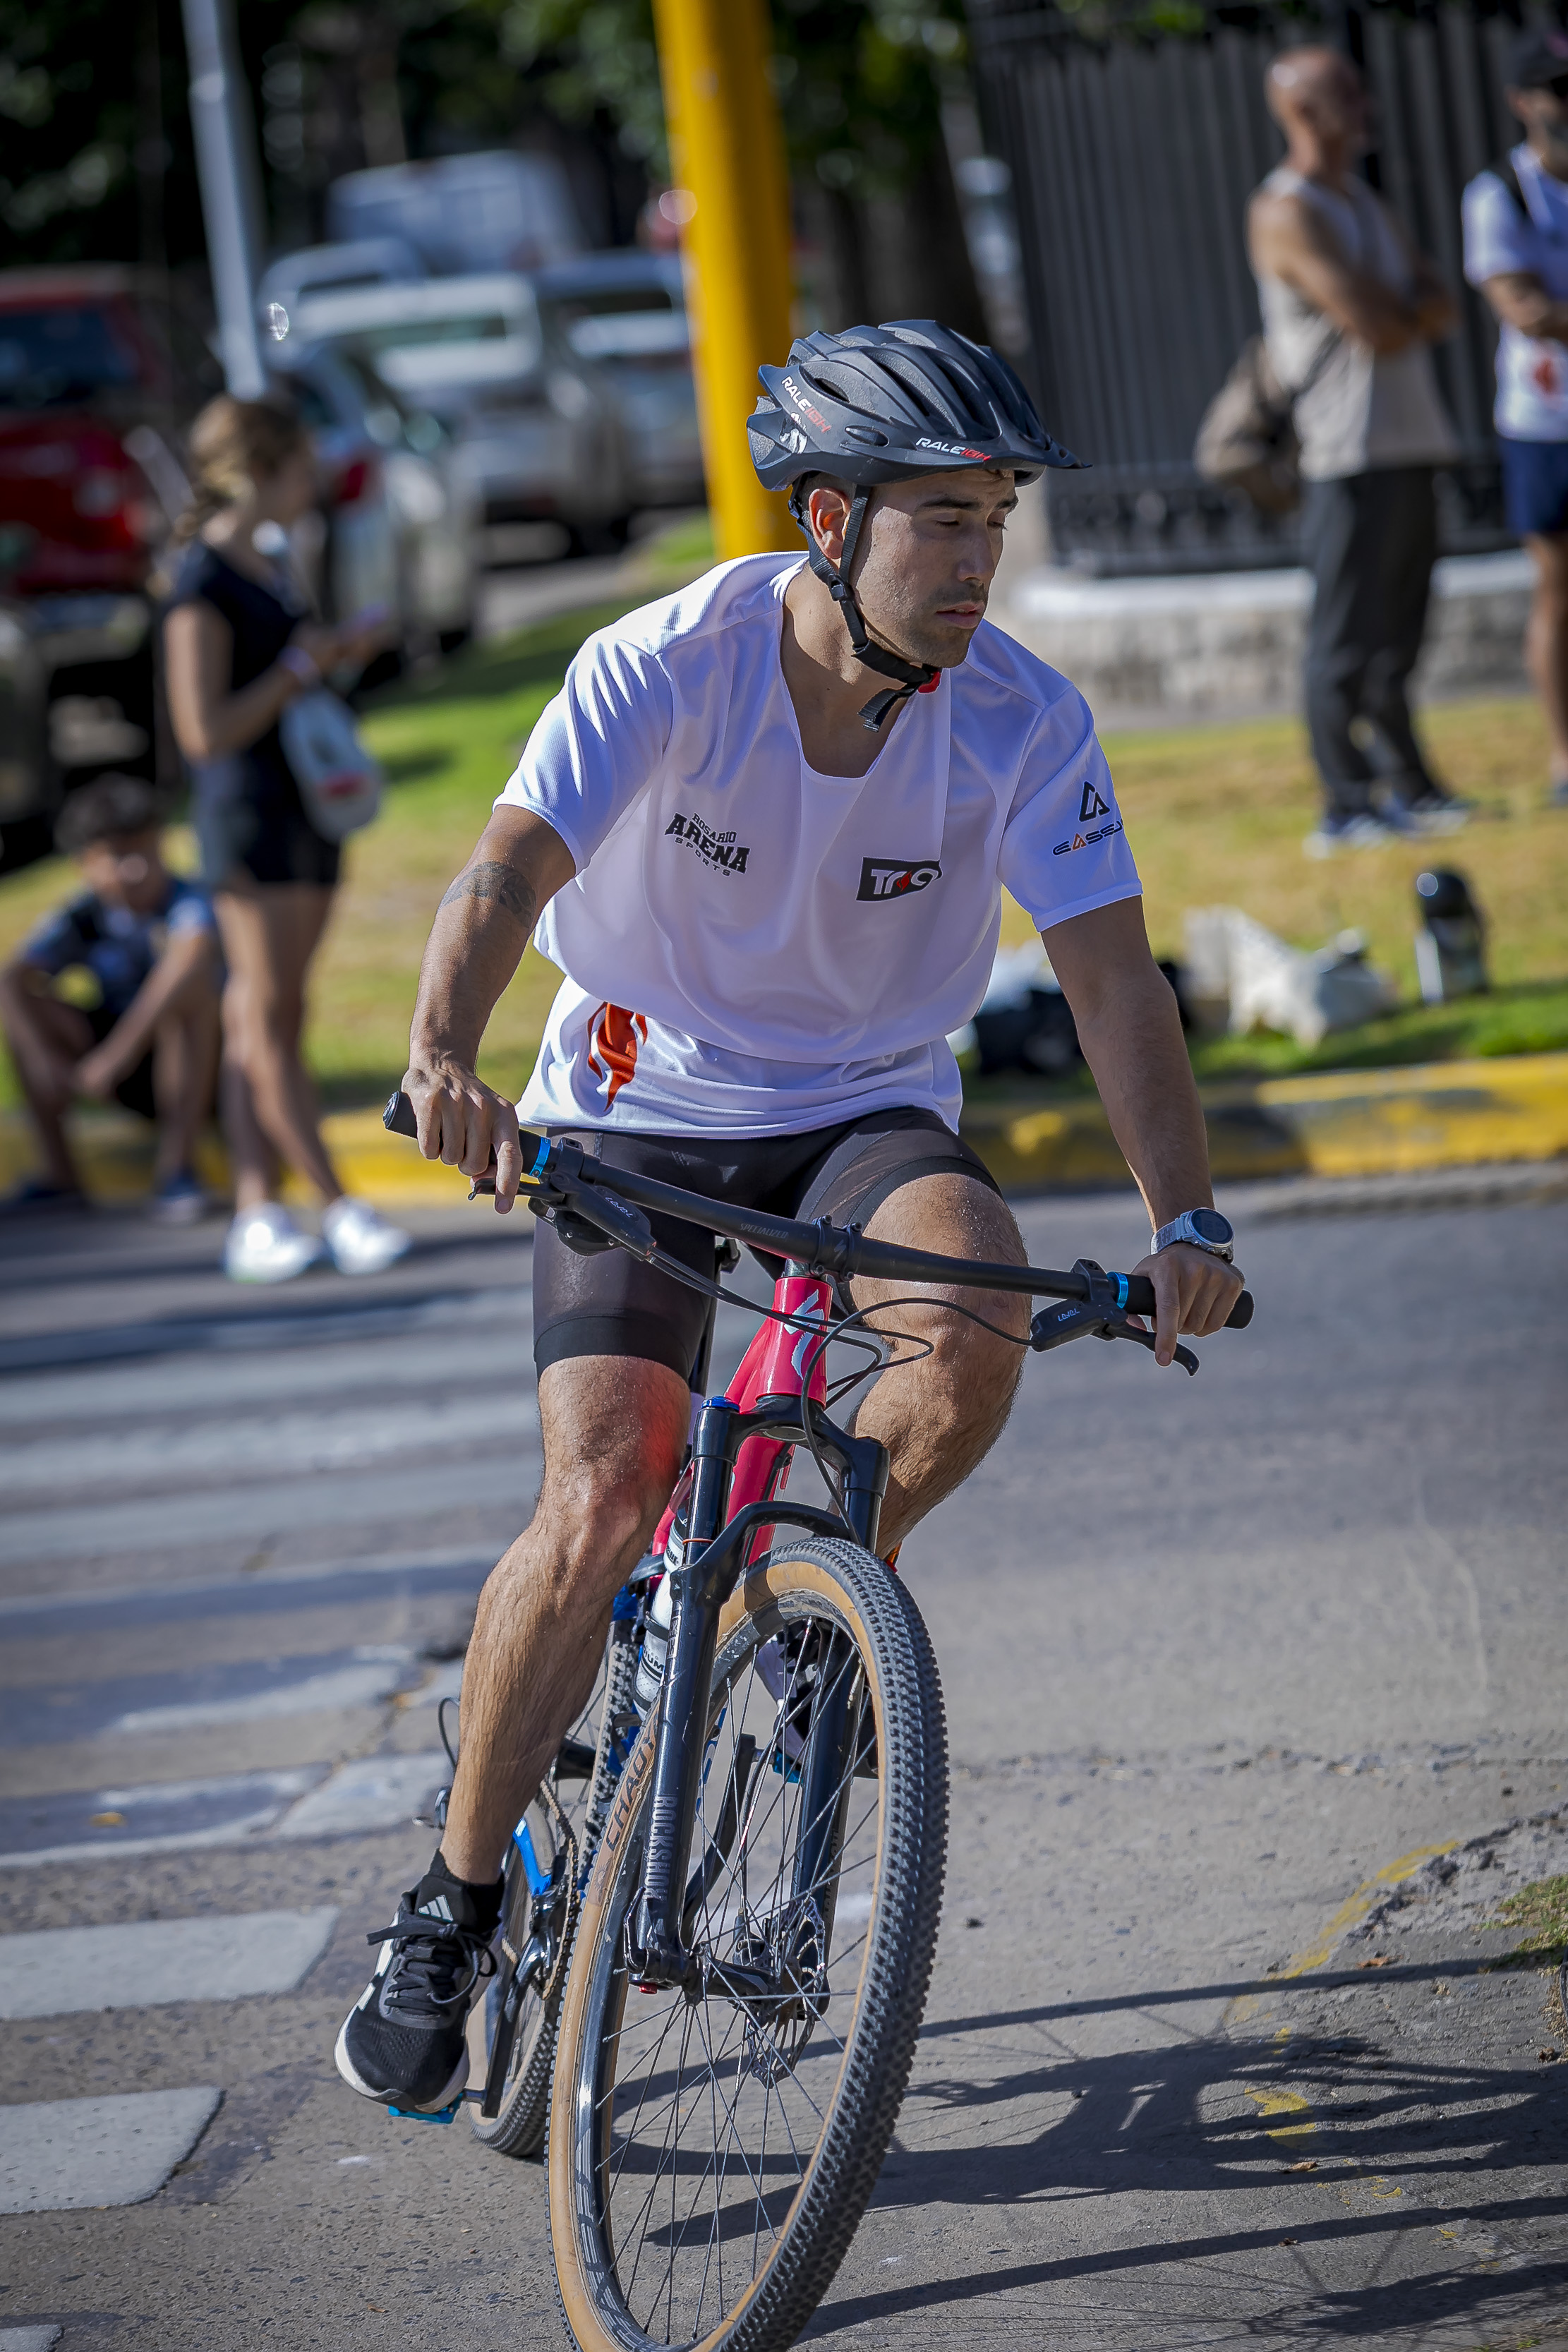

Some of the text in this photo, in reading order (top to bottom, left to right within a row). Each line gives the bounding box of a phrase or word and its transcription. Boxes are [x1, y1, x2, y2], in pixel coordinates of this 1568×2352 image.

[781, 375, 832, 433] RALEIGH
[915, 437, 991, 462] RALEIGH
[664, 812, 750, 874] ARENA
[692, 812, 737, 843] ROSARIO
[675, 836, 731, 876] SPORTS
[738, 1223, 789, 1239] SPECIALIZED
[643, 1796, 678, 1901] ROCKSHOX
